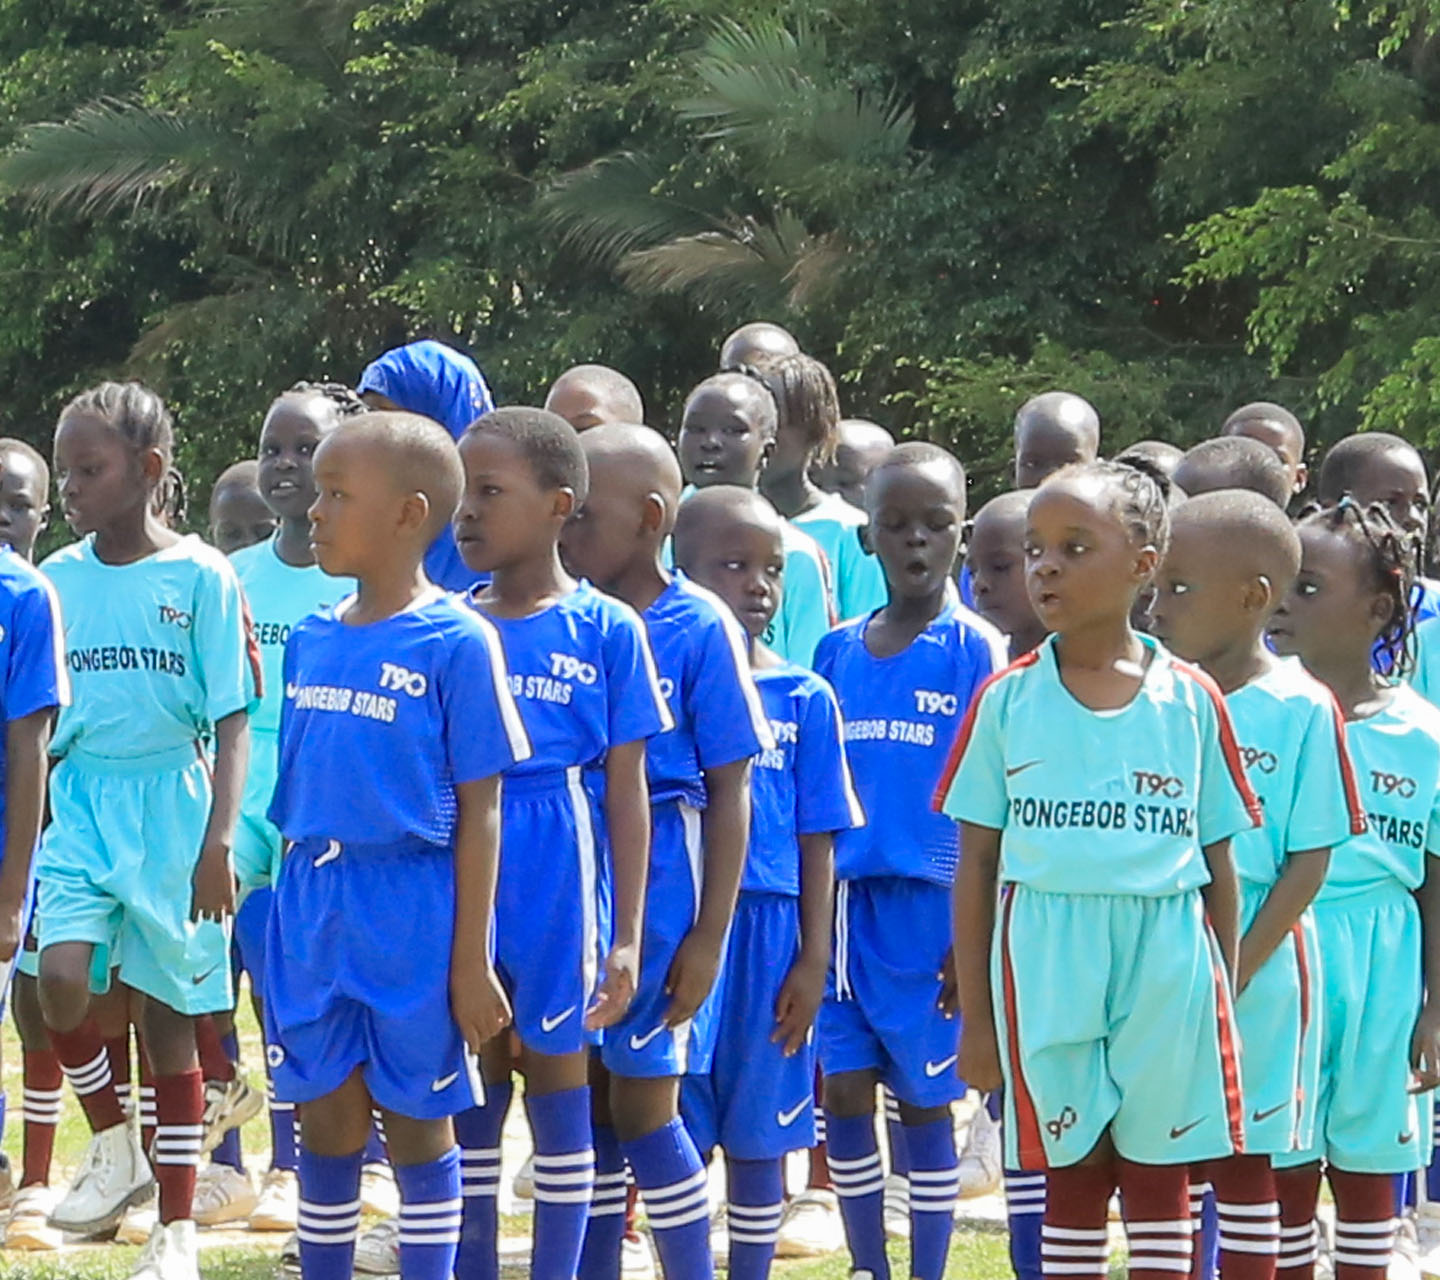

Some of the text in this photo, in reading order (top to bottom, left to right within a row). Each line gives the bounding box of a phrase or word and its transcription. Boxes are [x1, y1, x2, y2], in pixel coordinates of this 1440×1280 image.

[379, 663, 427, 698] T90
[550, 653, 597, 685] T90
[525, 677, 573, 705] STARS
[352, 691, 397, 723] STARS
[888, 720, 935, 746] STARS
[1133, 771, 1184, 799] T90
[1371, 770, 1417, 798] T90
[1010, 797, 1127, 829] PONGEBOB
